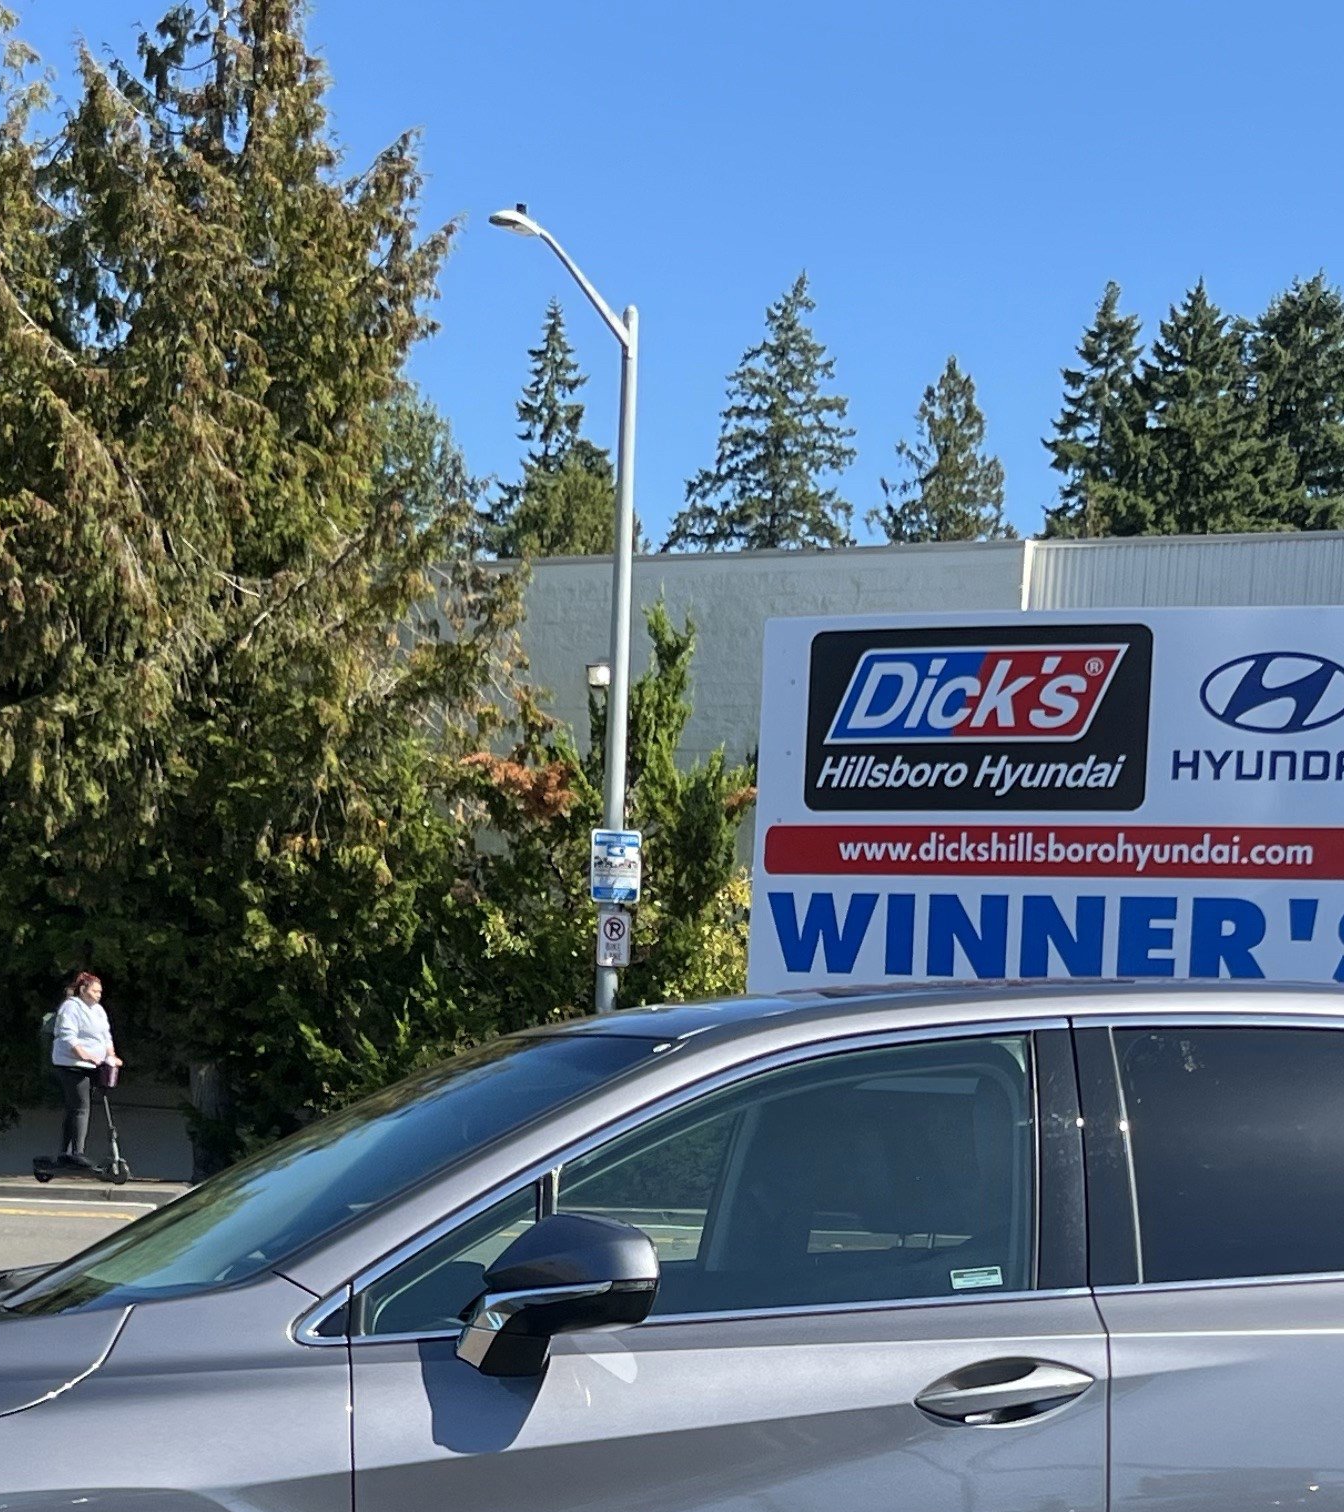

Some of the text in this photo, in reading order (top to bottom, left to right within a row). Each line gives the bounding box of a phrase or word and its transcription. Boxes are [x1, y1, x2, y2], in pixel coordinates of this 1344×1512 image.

[816, 752, 1128, 796] Hillsboro Hyundai
[838, 832, 1314, 872] www.dickshillsborohyundai.com
